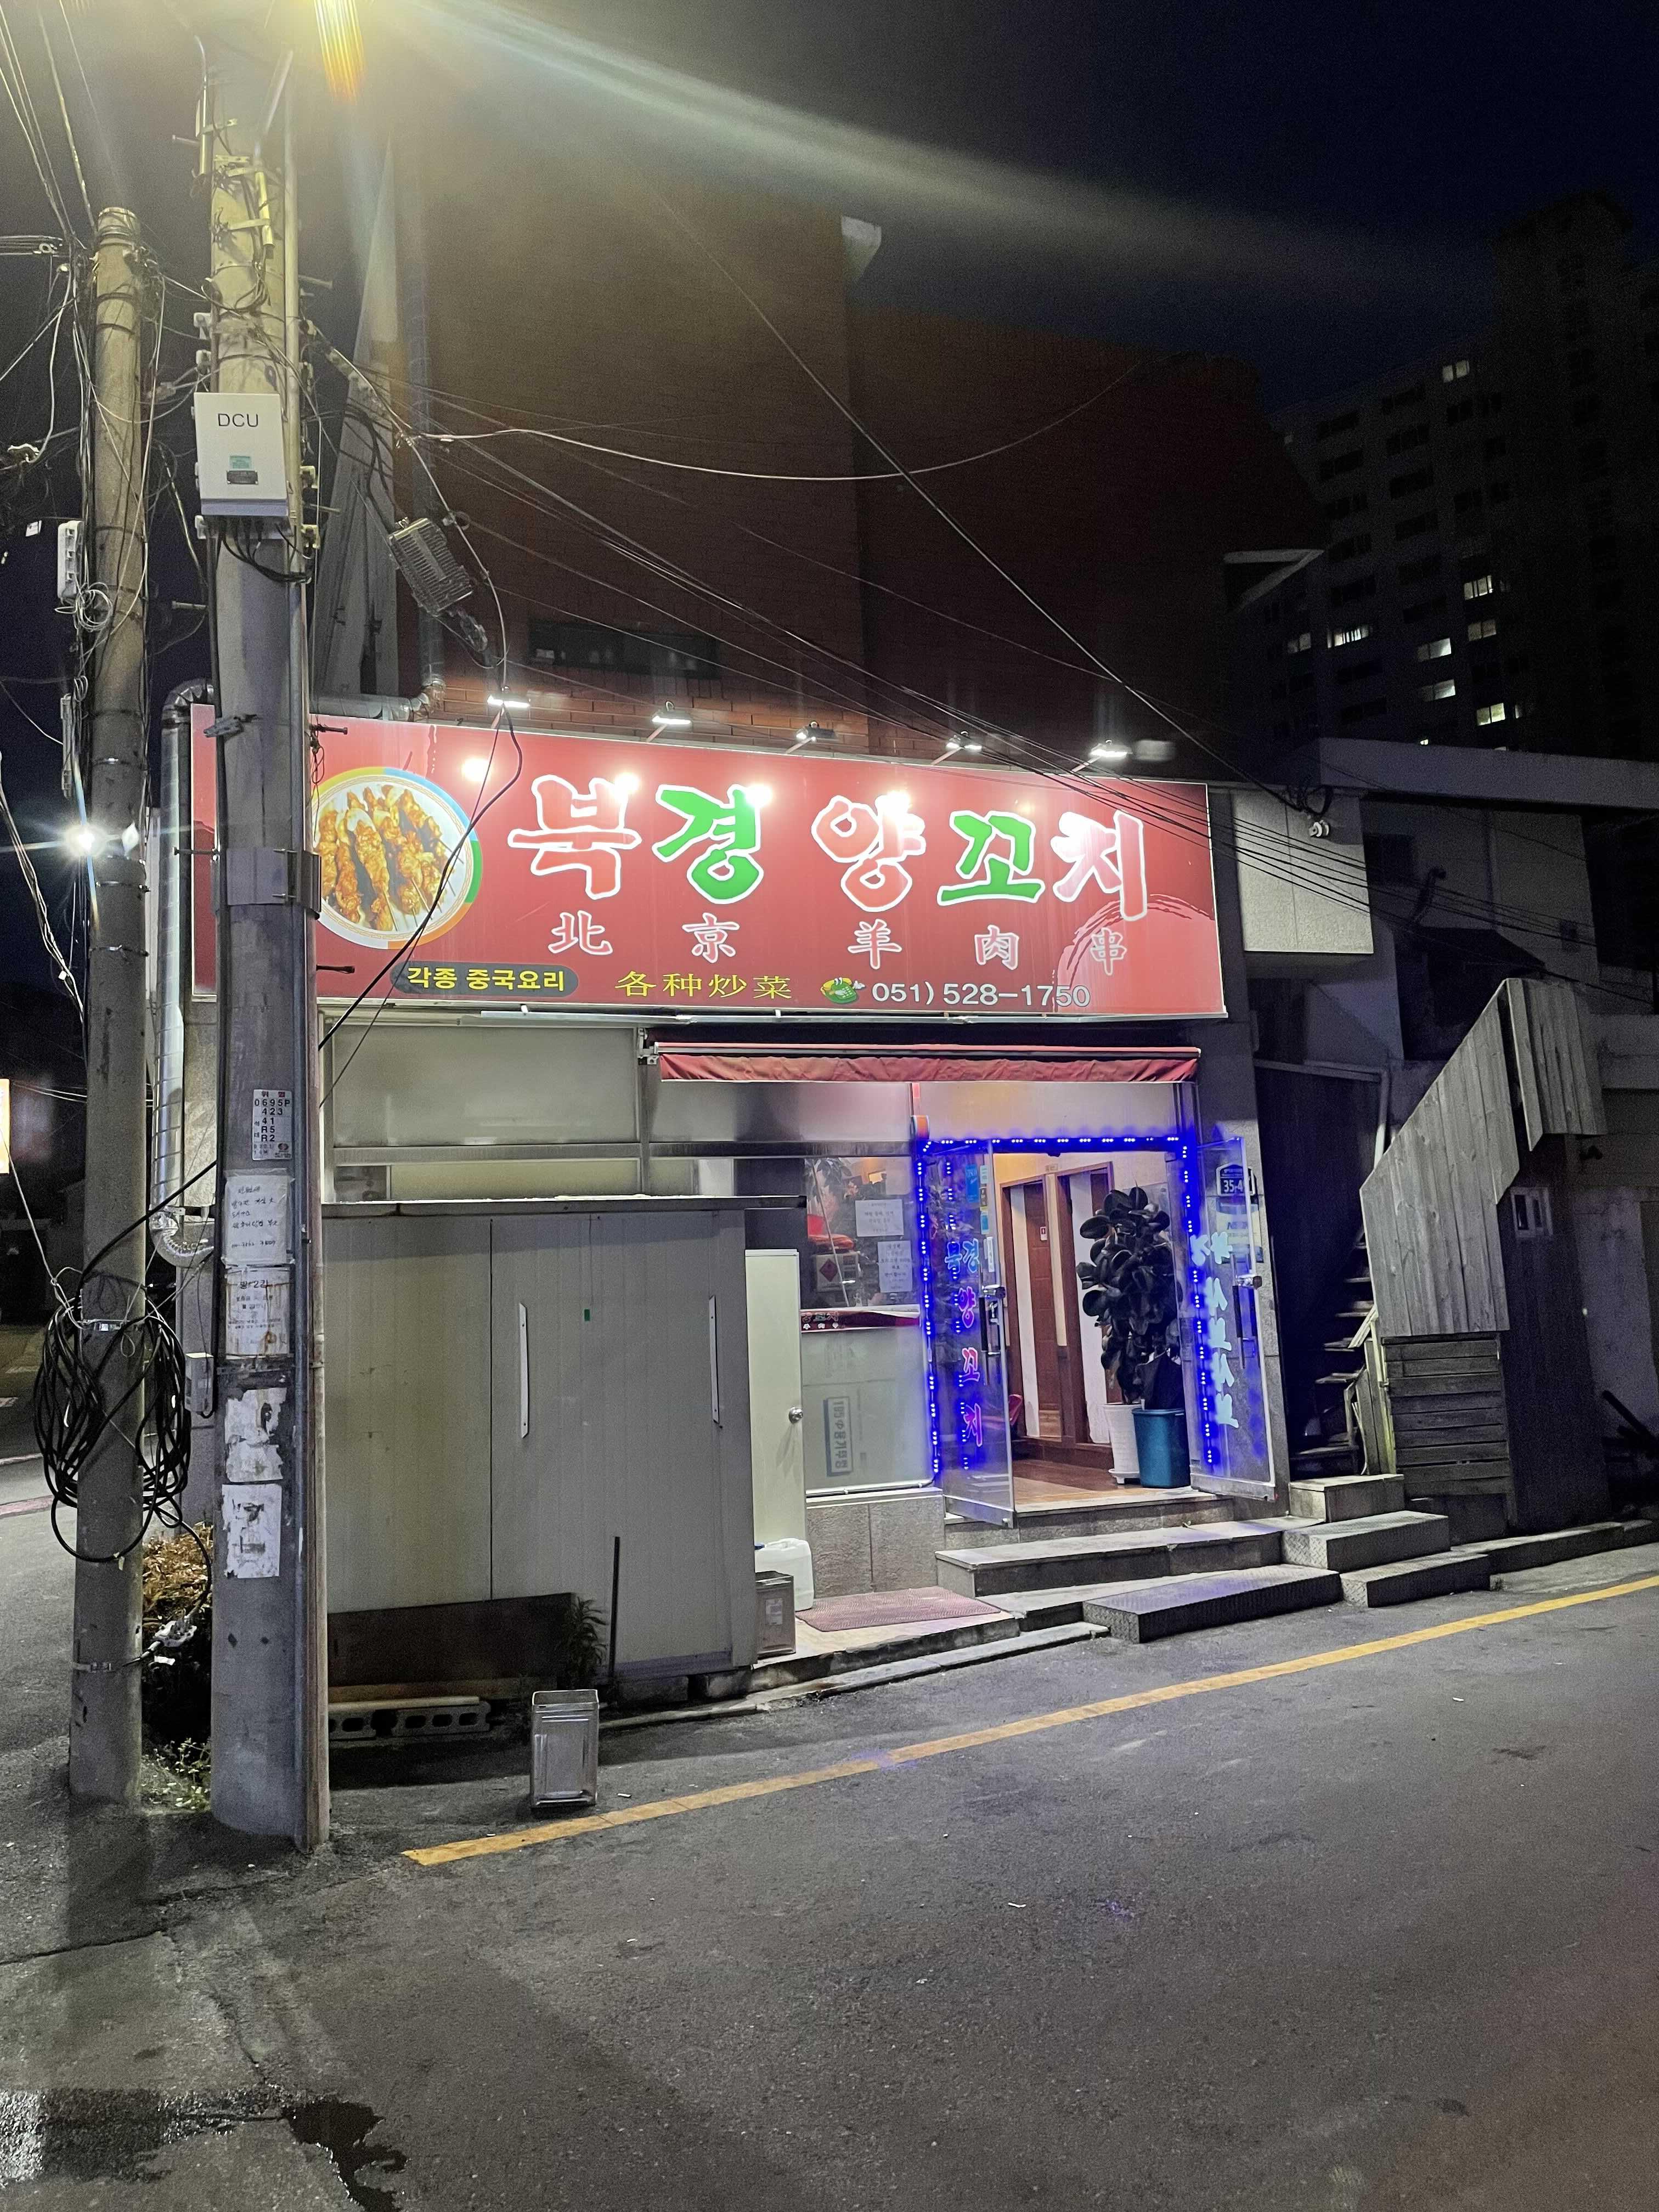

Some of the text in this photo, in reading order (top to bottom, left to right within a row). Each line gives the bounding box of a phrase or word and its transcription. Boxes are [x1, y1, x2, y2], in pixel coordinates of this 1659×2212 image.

[218, 413, 258, 427] DCU
[507, 774, 1148, 921] 북경 양꼬치
[408, 966, 564, 992] 각종 중국요리
[614, 970, 792, 1000] 各种炒菜
[871, 981, 1091, 1007] 051) 528-1750
